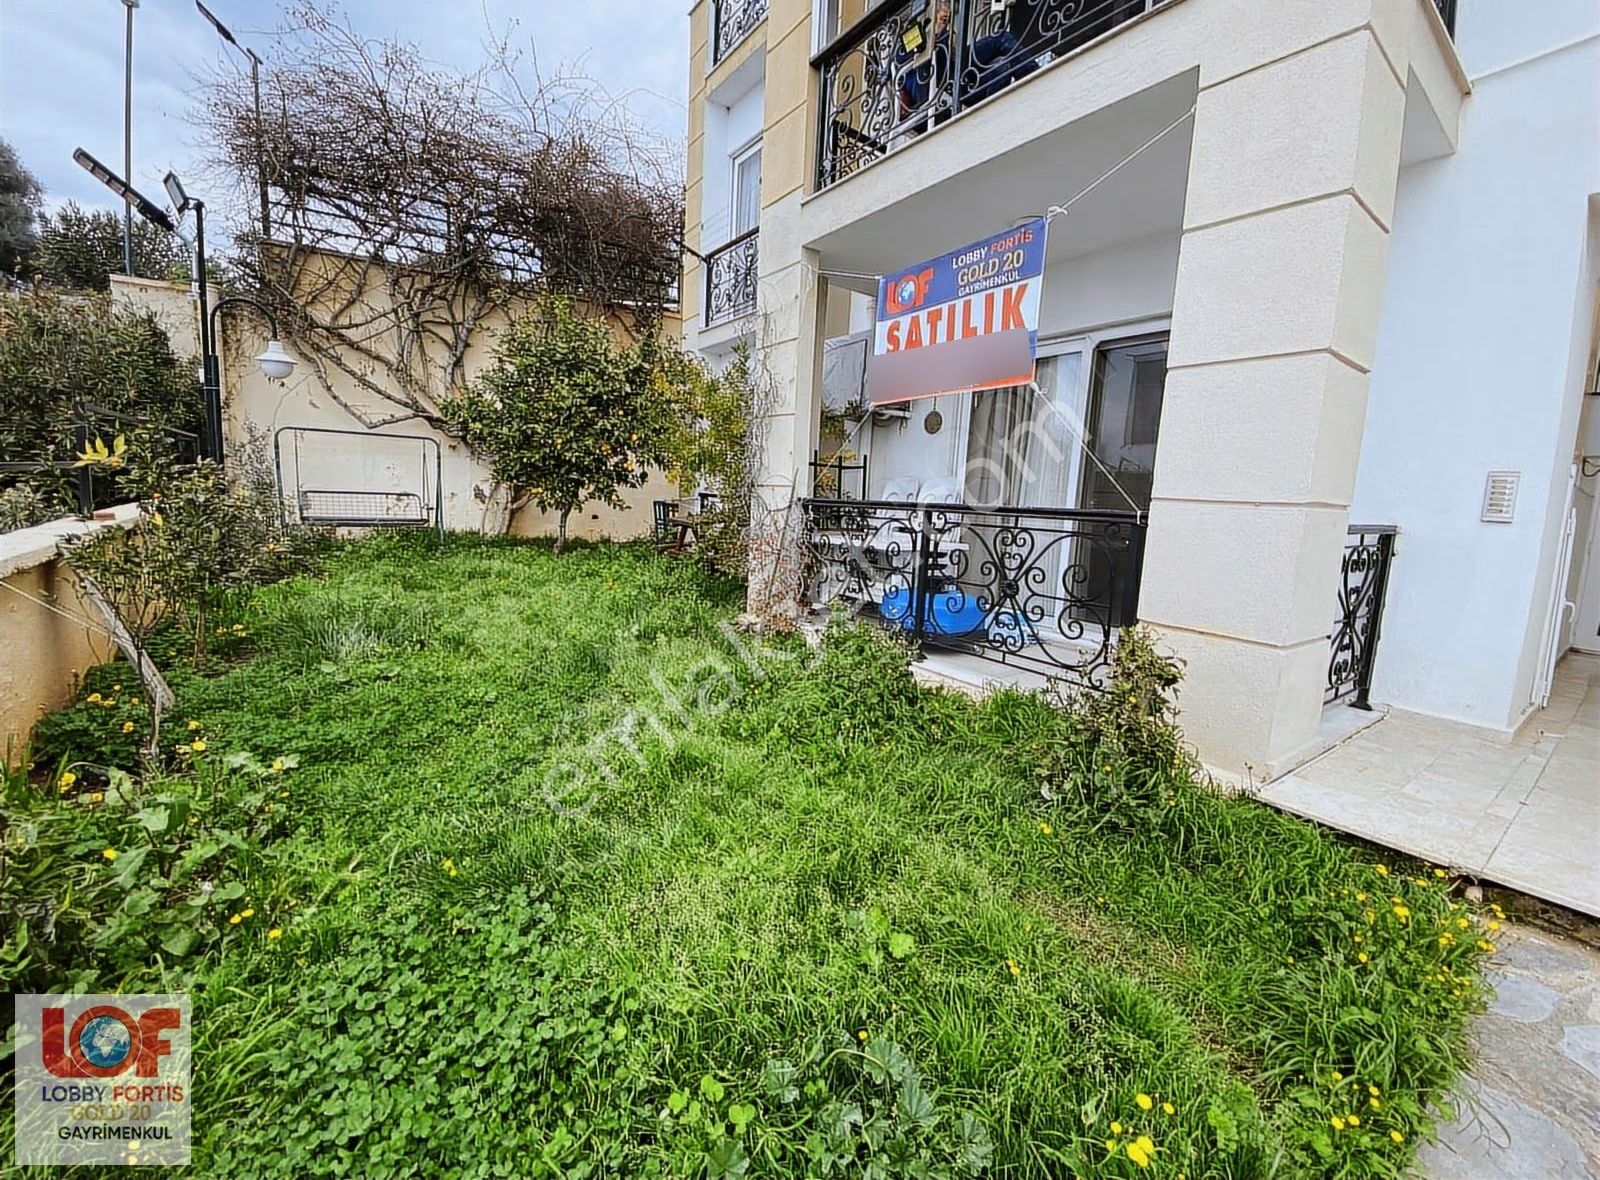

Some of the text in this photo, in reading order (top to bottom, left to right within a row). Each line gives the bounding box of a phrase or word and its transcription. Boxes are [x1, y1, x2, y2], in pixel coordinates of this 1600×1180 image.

[952, 246, 988, 269] LOBBY
[957, 249, 1024, 286] GOLD 20
[885, 268, 934, 315] LOF
[886, 283, 1029, 353] SATILIK
